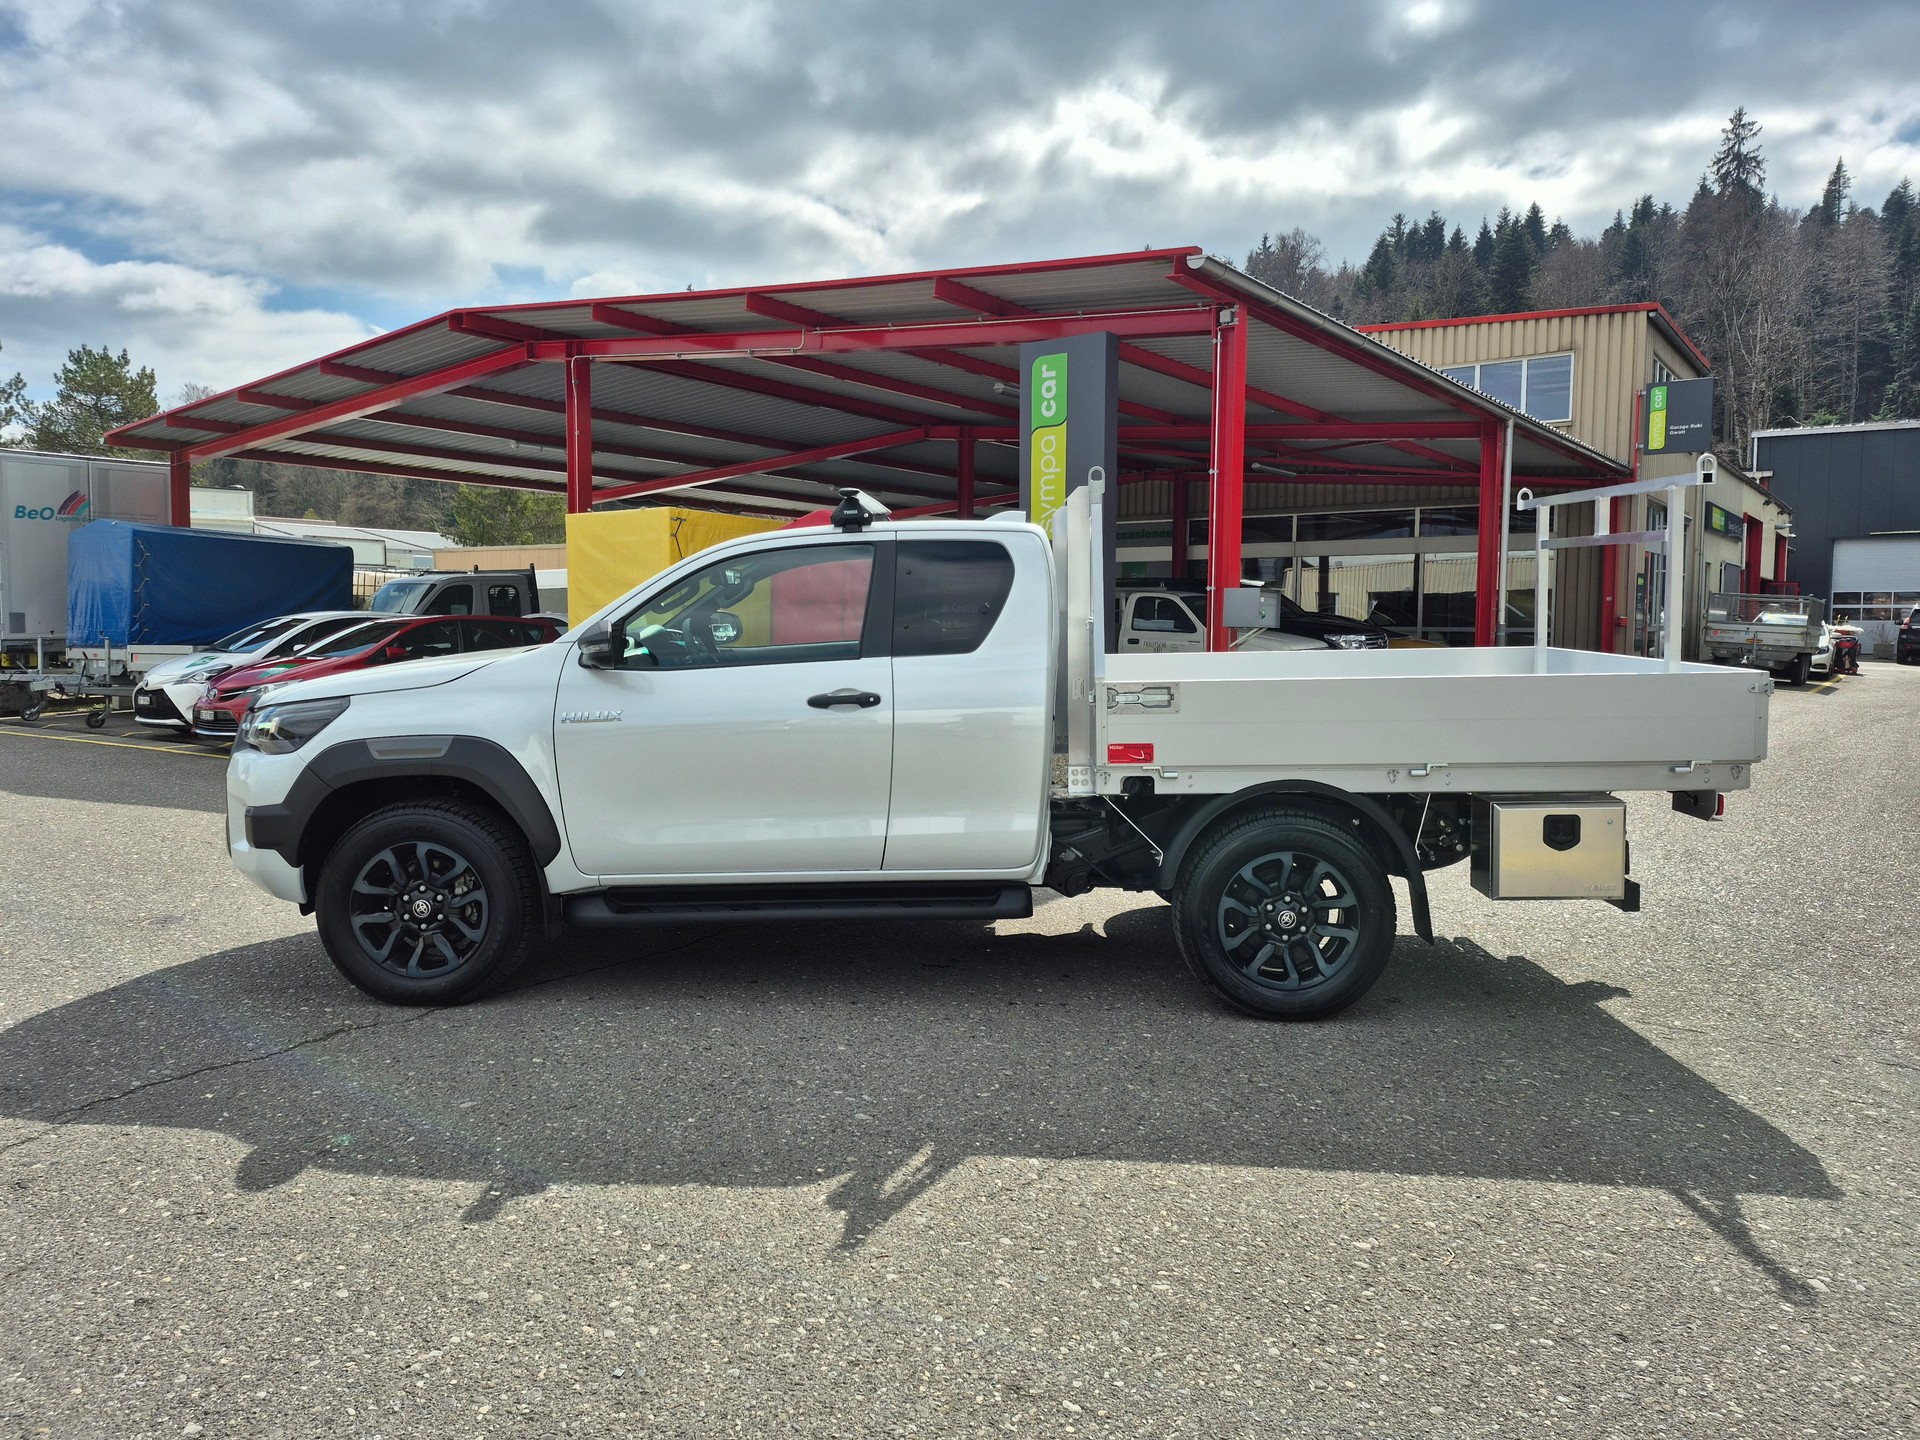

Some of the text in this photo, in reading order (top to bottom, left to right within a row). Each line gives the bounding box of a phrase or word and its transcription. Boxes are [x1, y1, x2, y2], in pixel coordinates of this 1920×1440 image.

[1041, 364, 1057, 418] car
[1653, 390, 1664, 447] sympa car
[14, 505, 55, 521] BeO
[1115, 529, 1173, 541] ccasionen
[561, 710, 624, 724] HILUX
